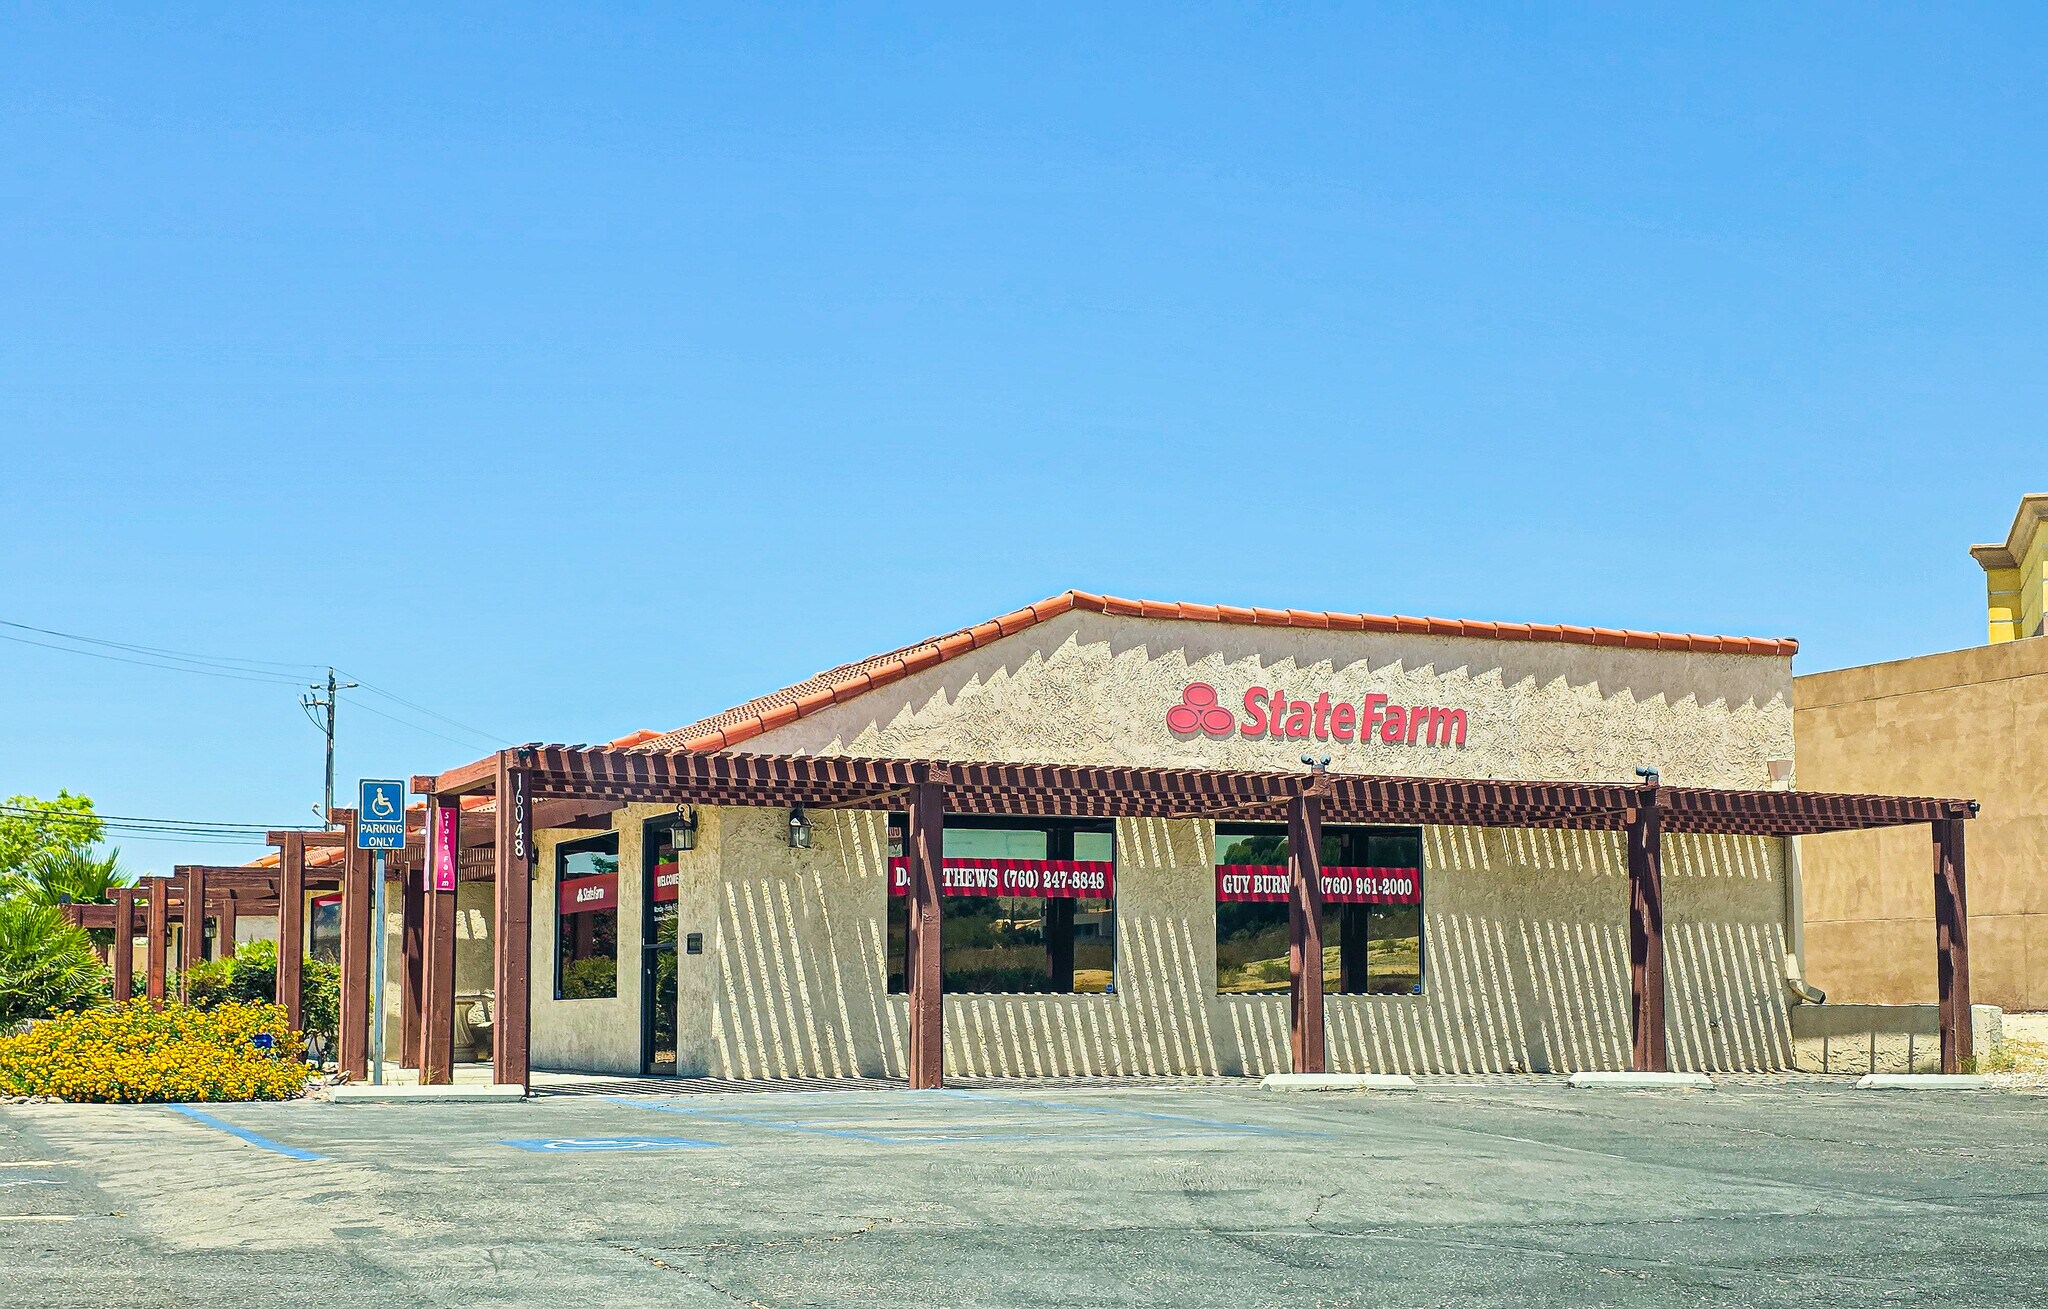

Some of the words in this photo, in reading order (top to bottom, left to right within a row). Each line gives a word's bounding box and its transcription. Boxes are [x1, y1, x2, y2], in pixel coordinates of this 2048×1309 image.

[515, 773, 524, 857] 16048
[360, 824, 403, 834] PARKING
[368, 836, 395, 847] ONLY
[942, 867, 998, 888] THEWS
[1003, 869, 1039, 889] (760)
[1043, 870, 1105, 890] 247-8848
[1222, 874, 1251, 894] GUY
[1320, 876, 1352, 895] (760)
[1356, 878, 1413, 896] 961-2000
